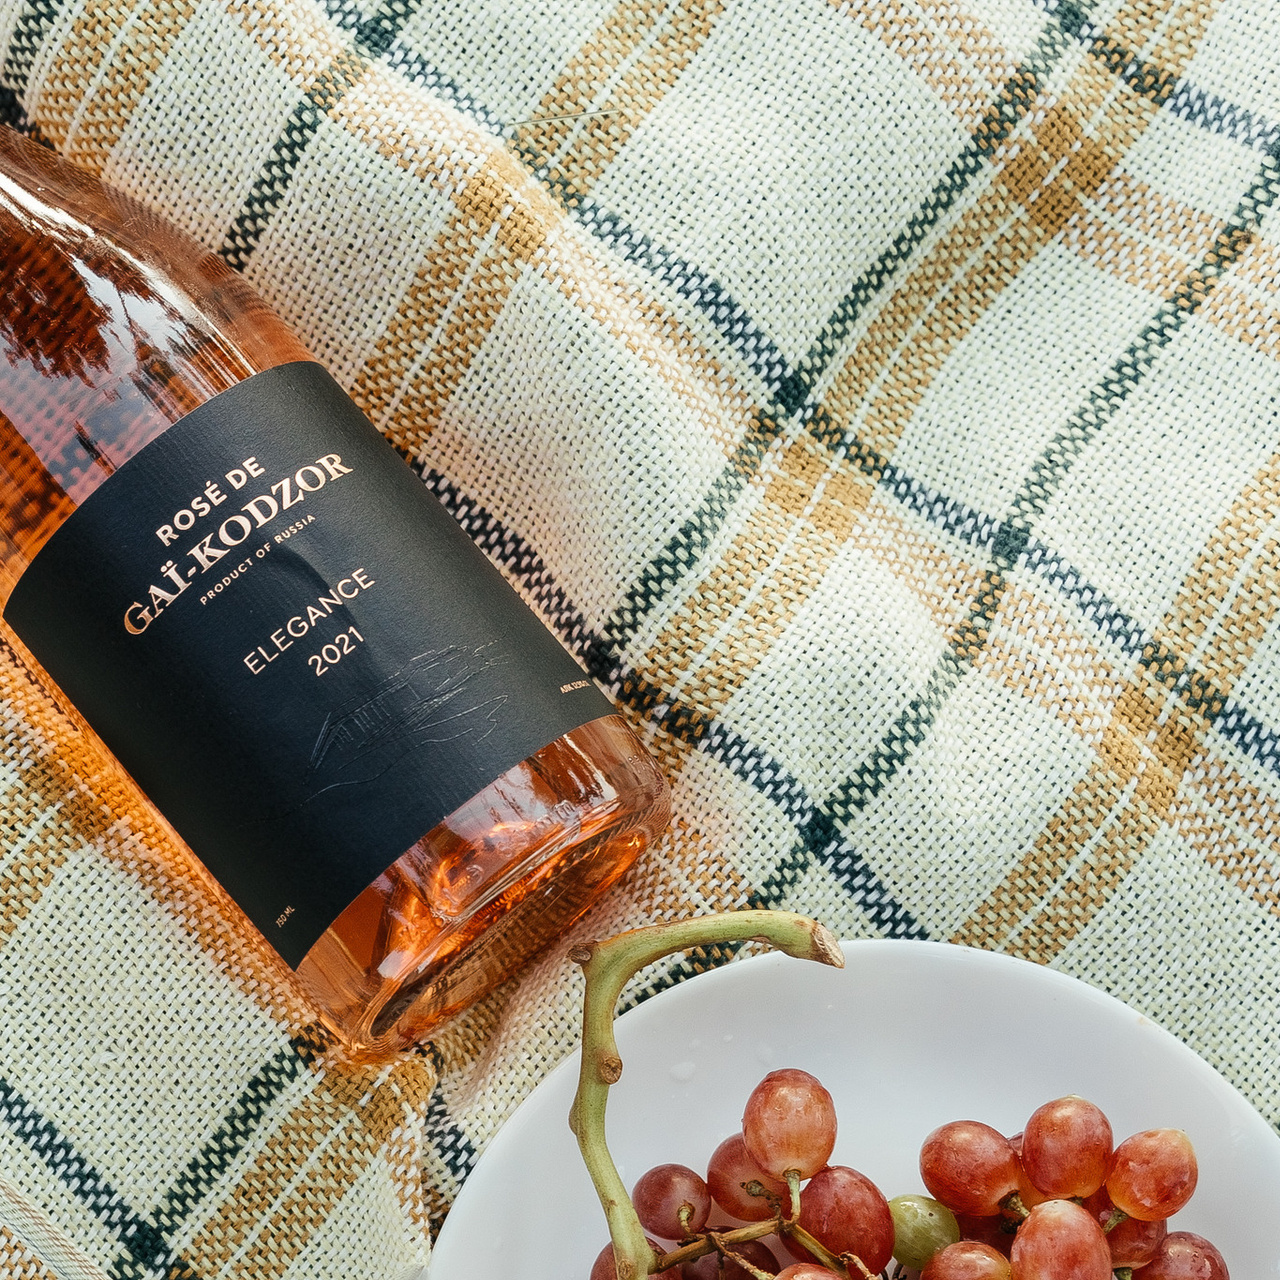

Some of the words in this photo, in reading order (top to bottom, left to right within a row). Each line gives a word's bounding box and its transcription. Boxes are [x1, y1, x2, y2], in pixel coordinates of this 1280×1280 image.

[123, 453, 354, 635] GAÏ-KODZOR
[155, 480, 228, 547] ROSÉ
[225, 456, 266, 490] DE
[200, 557, 254, 605] PRODUCT
[255, 542, 271, 559] OF
[274, 514, 317, 544] RUSSIA
[243, 567, 376, 675] ELEGANCE
[308, 626, 364, 677] 2021
[284, 905, 295, 917] ML
